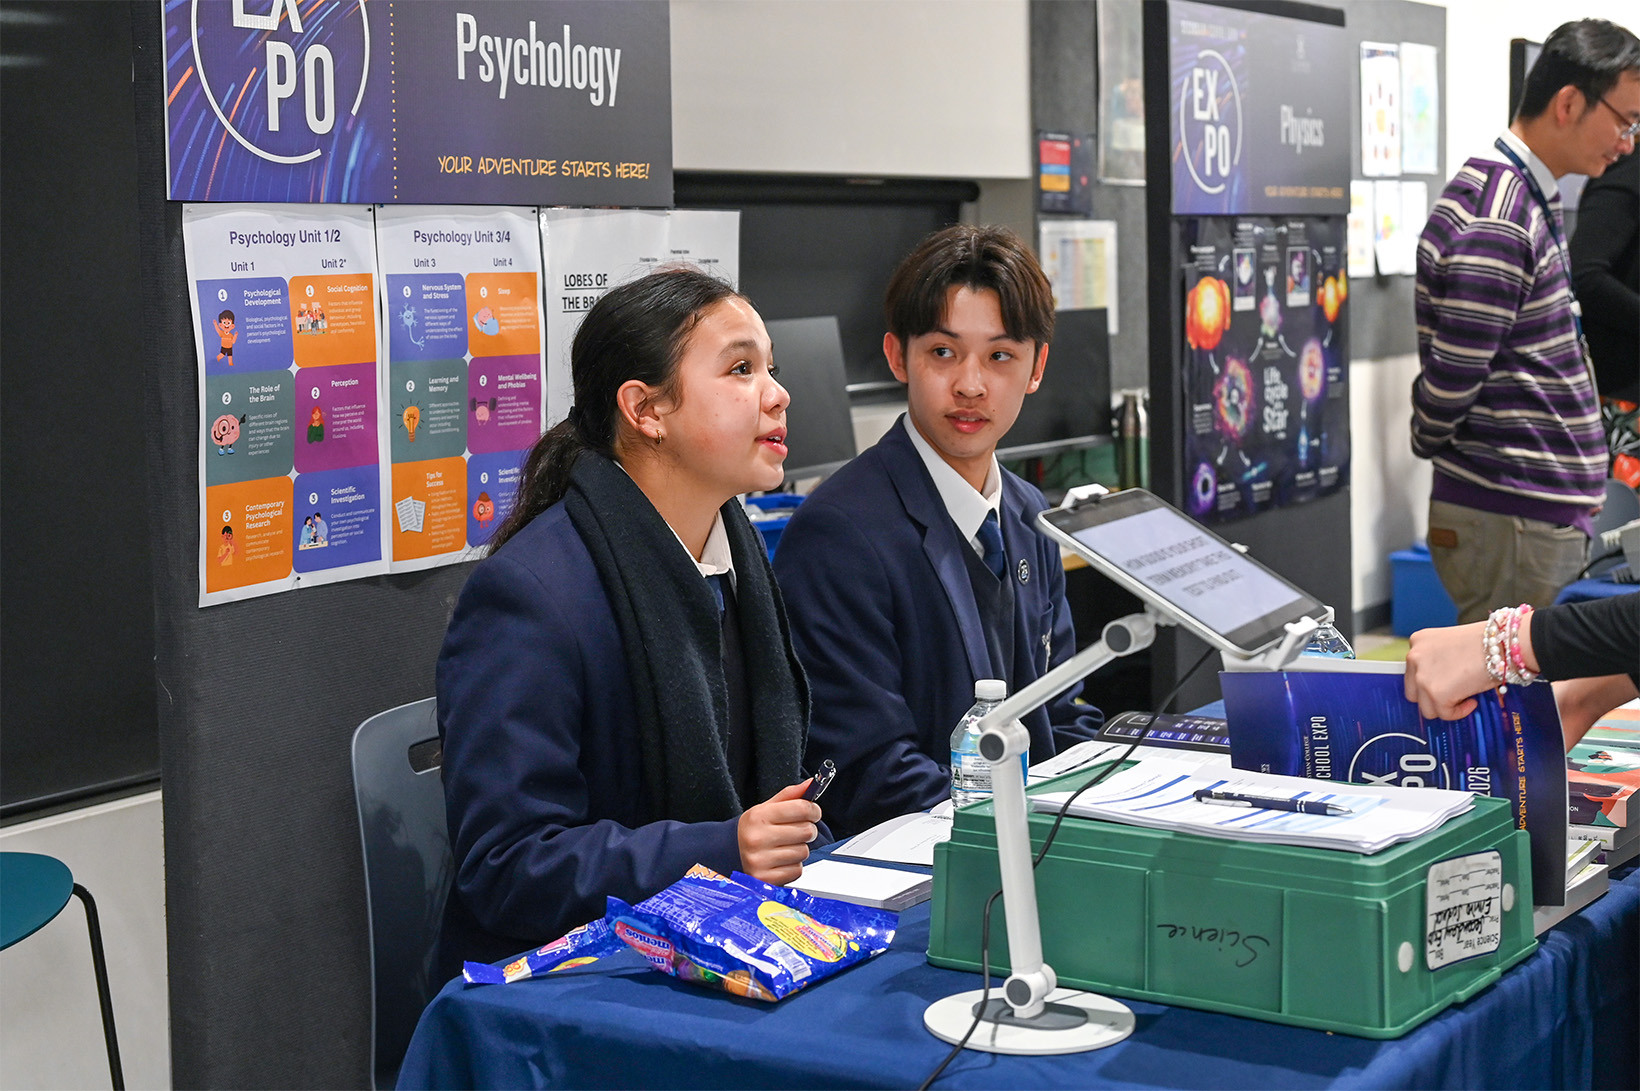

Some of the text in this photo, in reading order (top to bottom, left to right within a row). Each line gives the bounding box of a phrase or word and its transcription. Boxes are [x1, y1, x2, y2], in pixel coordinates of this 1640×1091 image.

[456, 13, 621, 107] Psychology
[266, 40, 335, 135] PO
[1192, 67, 1220, 122] EX
[1280, 104, 1325, 155] Physics
[1204, 124, 1231, 177] PO
[438, 156, 650, 180] YOUR ADVENTURE STARTS HERE!
[230, 230, 341, 247] Psychology Unit 1/2
[414, 230, 511, 246] Psychology Unit 3/4
[231, 262, 249, 272] Unit
[322, 259, 338, 269] Unit
[414, 258, 436, 268] Unit 3
[493, 258, 513, 267] Unit 4
[564, 273, 608, 287] LOBES OF
[244, 288, 281, 298] Psychological
[327, 284, 368, 294] Social Cognition
[444, 283, 462, 292] System
[245, 298, 281, 307] Development
[562, 296, 580, 309] THE
[429, 375, 459, 385] Learning and
[515, 373, 538, 381] Wellbeing
[331, 378, 359, 388] Perception
[498, 381, 526, 390] and Phobias
[249, 386, 260, 394] The
[274, 384, 280, 392] of
[260, 394, 275, 402] Brain
[426, 472, 436, 480] Tips
[426, 480, 444, 488] Success
[331, 486, 356, 496] Scientific
[331, 493, 365, 504] Investigation
[245, 501, 285, 512] Contemporary
[245, 509, 282, 522] Psychological
[246, 520, 271, 530] Research
[1516, 736, 1525, 773] STARTS
[1314, 745, 1331, 778] CHOOL
[1362, 771, 1398, 788] X
[1467, 767, 1491, 797] 2026
[1518, 776, 1527, 830] ADVENTURE
[624, 928, 670, 951] mentos
[1463, 933, 1499, 950] Science Year
[1157, 924, 1270, 968] Science
